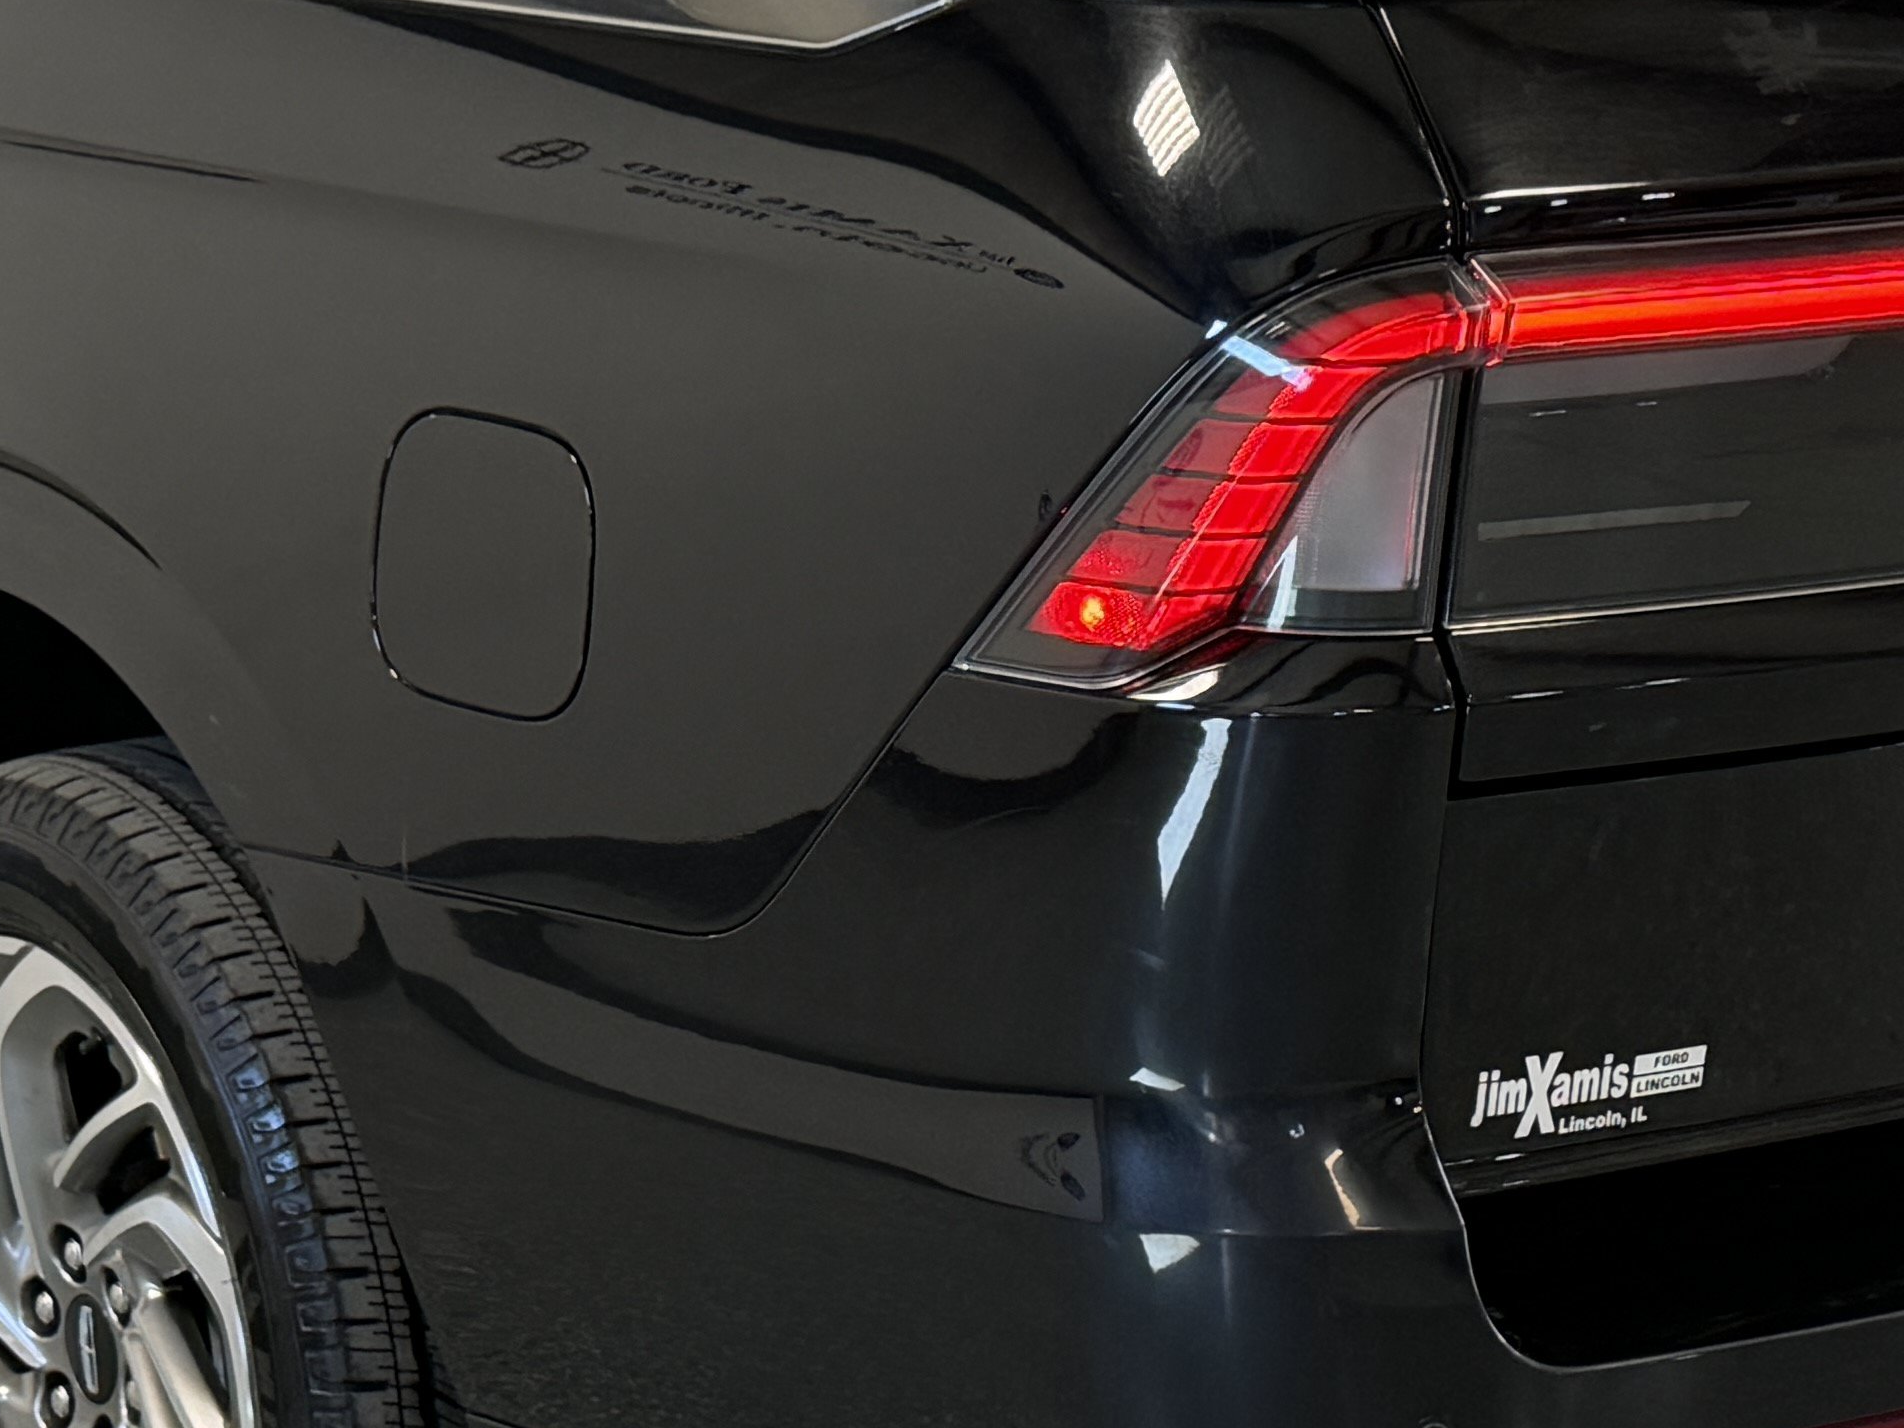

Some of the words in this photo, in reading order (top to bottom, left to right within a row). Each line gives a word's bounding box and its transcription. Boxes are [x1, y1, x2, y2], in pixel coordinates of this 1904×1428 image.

[1653, 1052, 1690, 1068] FORD
[1636, 1074, 1700, 1094] LINCOLN
[1558, 1110, 1626, 1135] Lincoln,
[1631, 1105, 1648, 1123] IL
